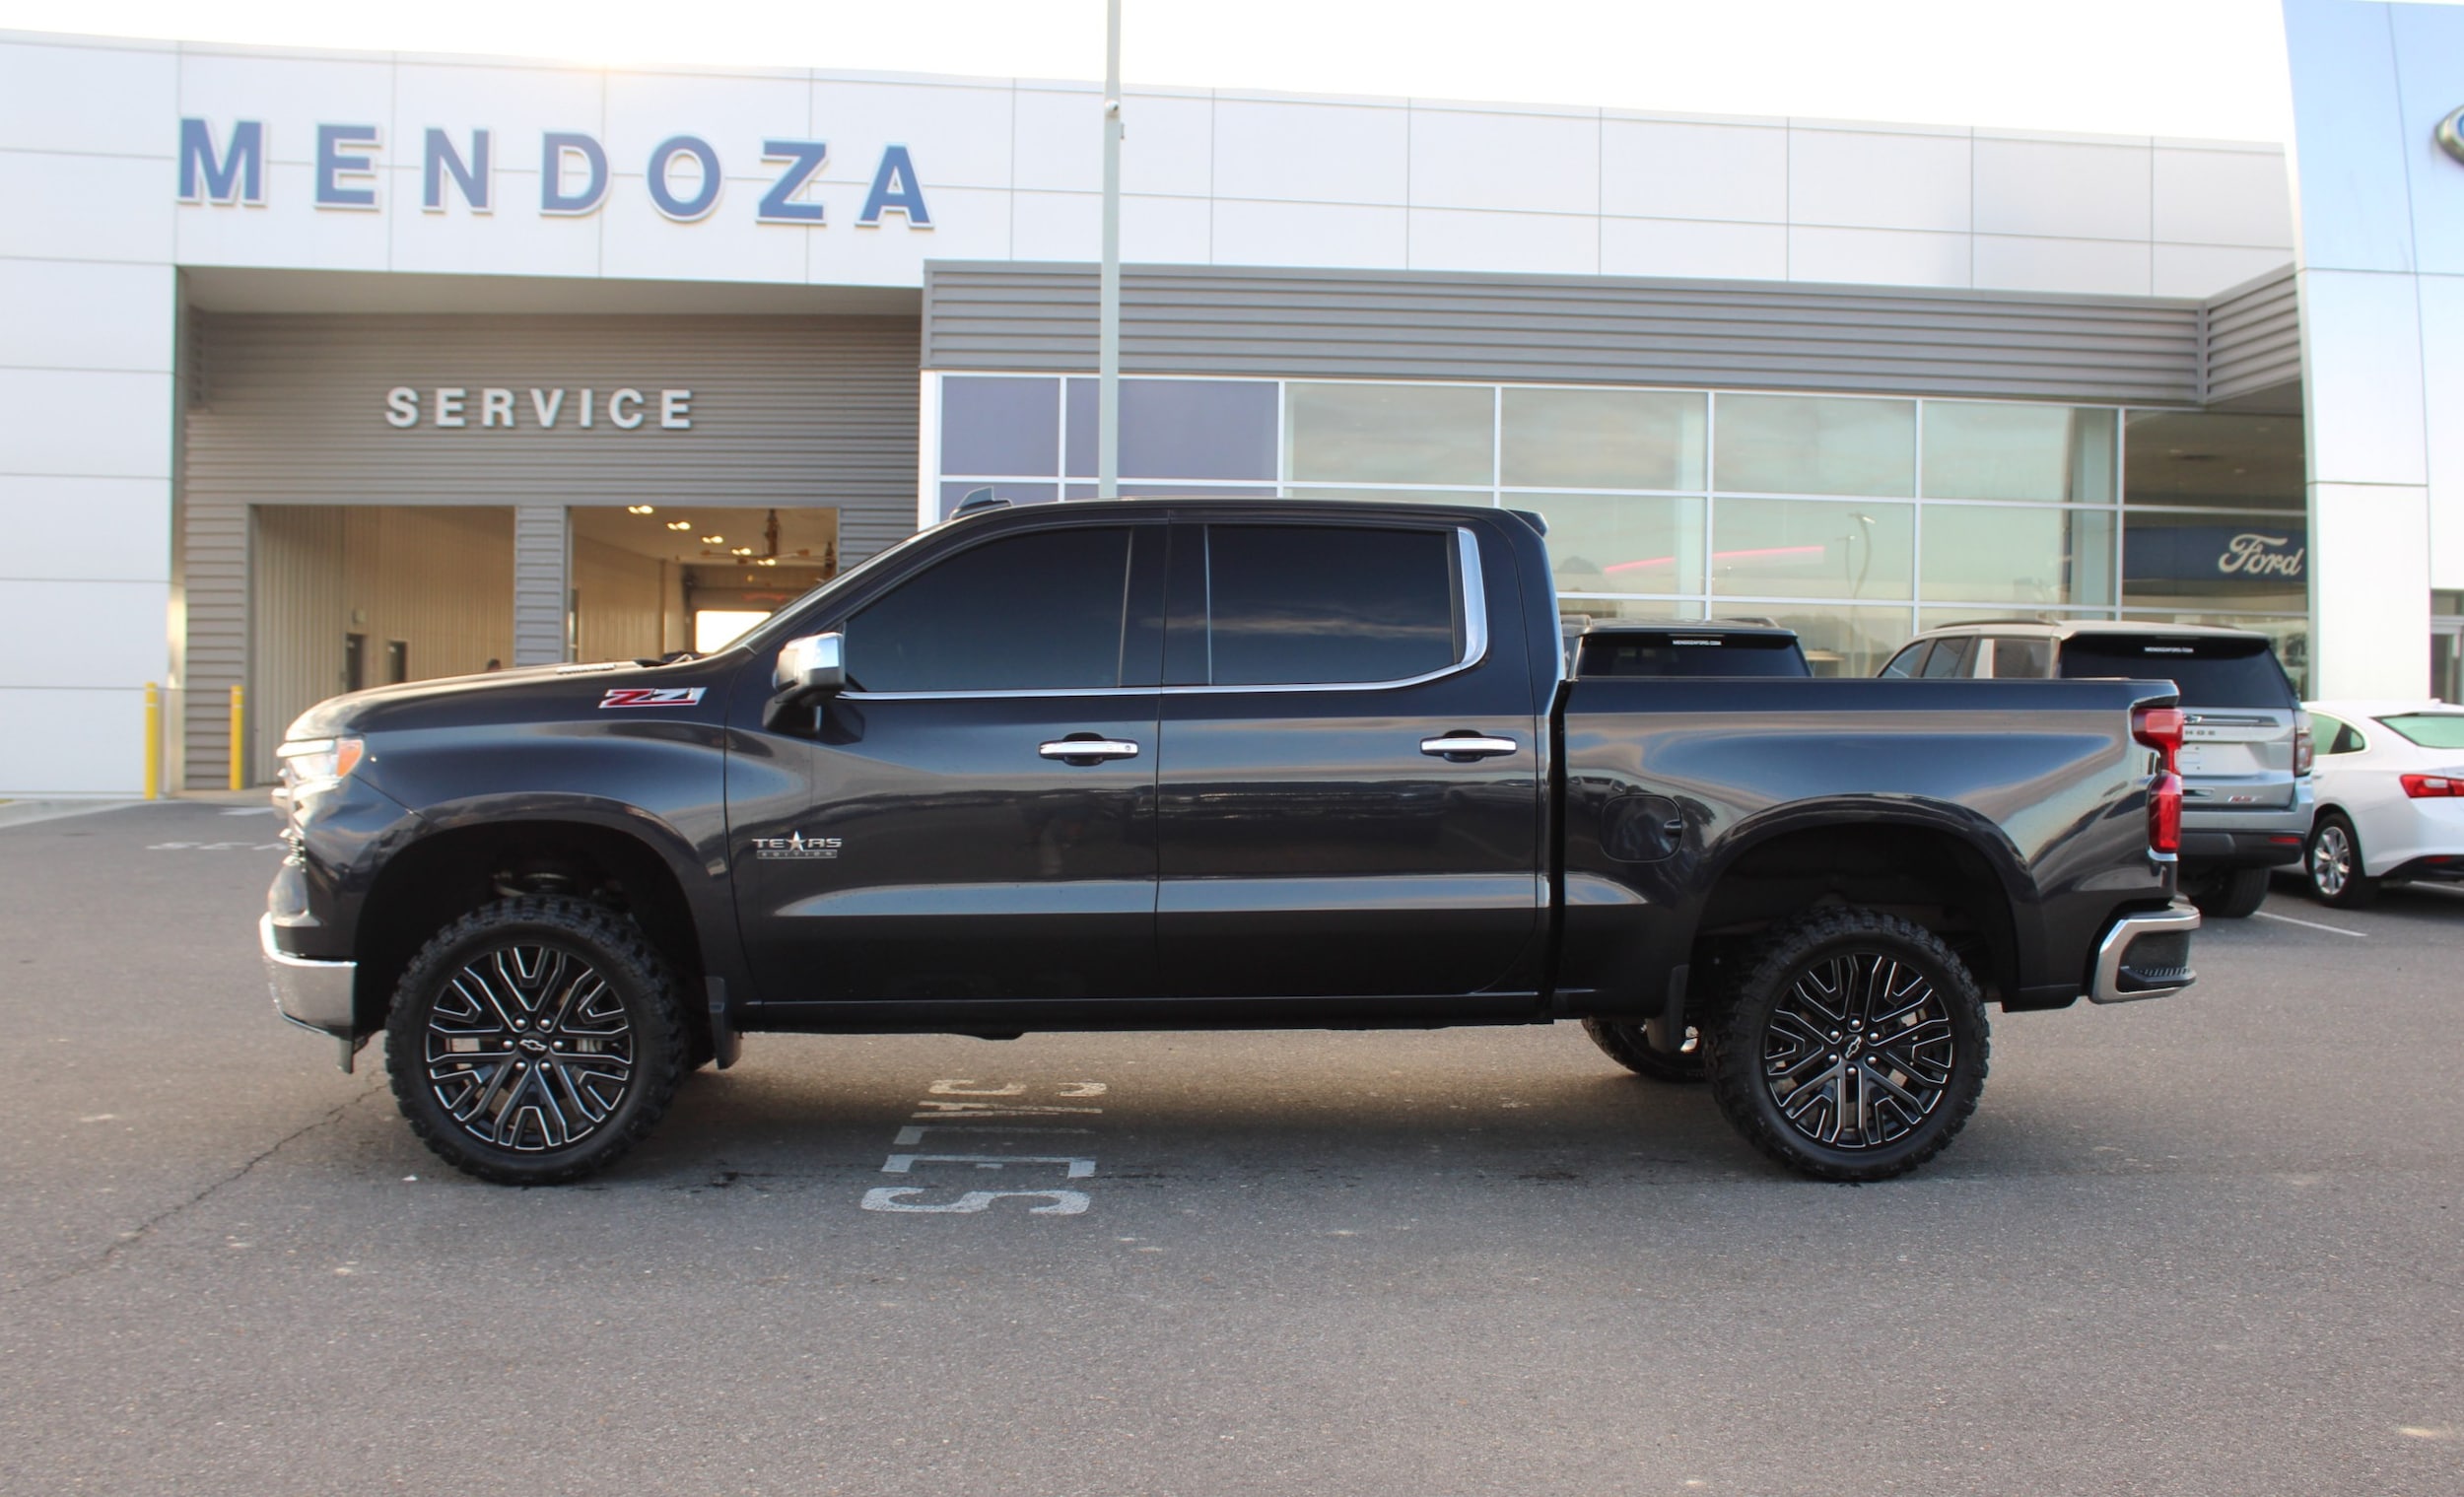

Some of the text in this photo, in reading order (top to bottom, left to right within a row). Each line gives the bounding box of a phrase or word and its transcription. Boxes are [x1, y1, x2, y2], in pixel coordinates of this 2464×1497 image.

[177, 116, 934, 229] MENDOZA
[385, 386, 692, 430] SERVICE
[2219, 533, 2305, 576] Ford
